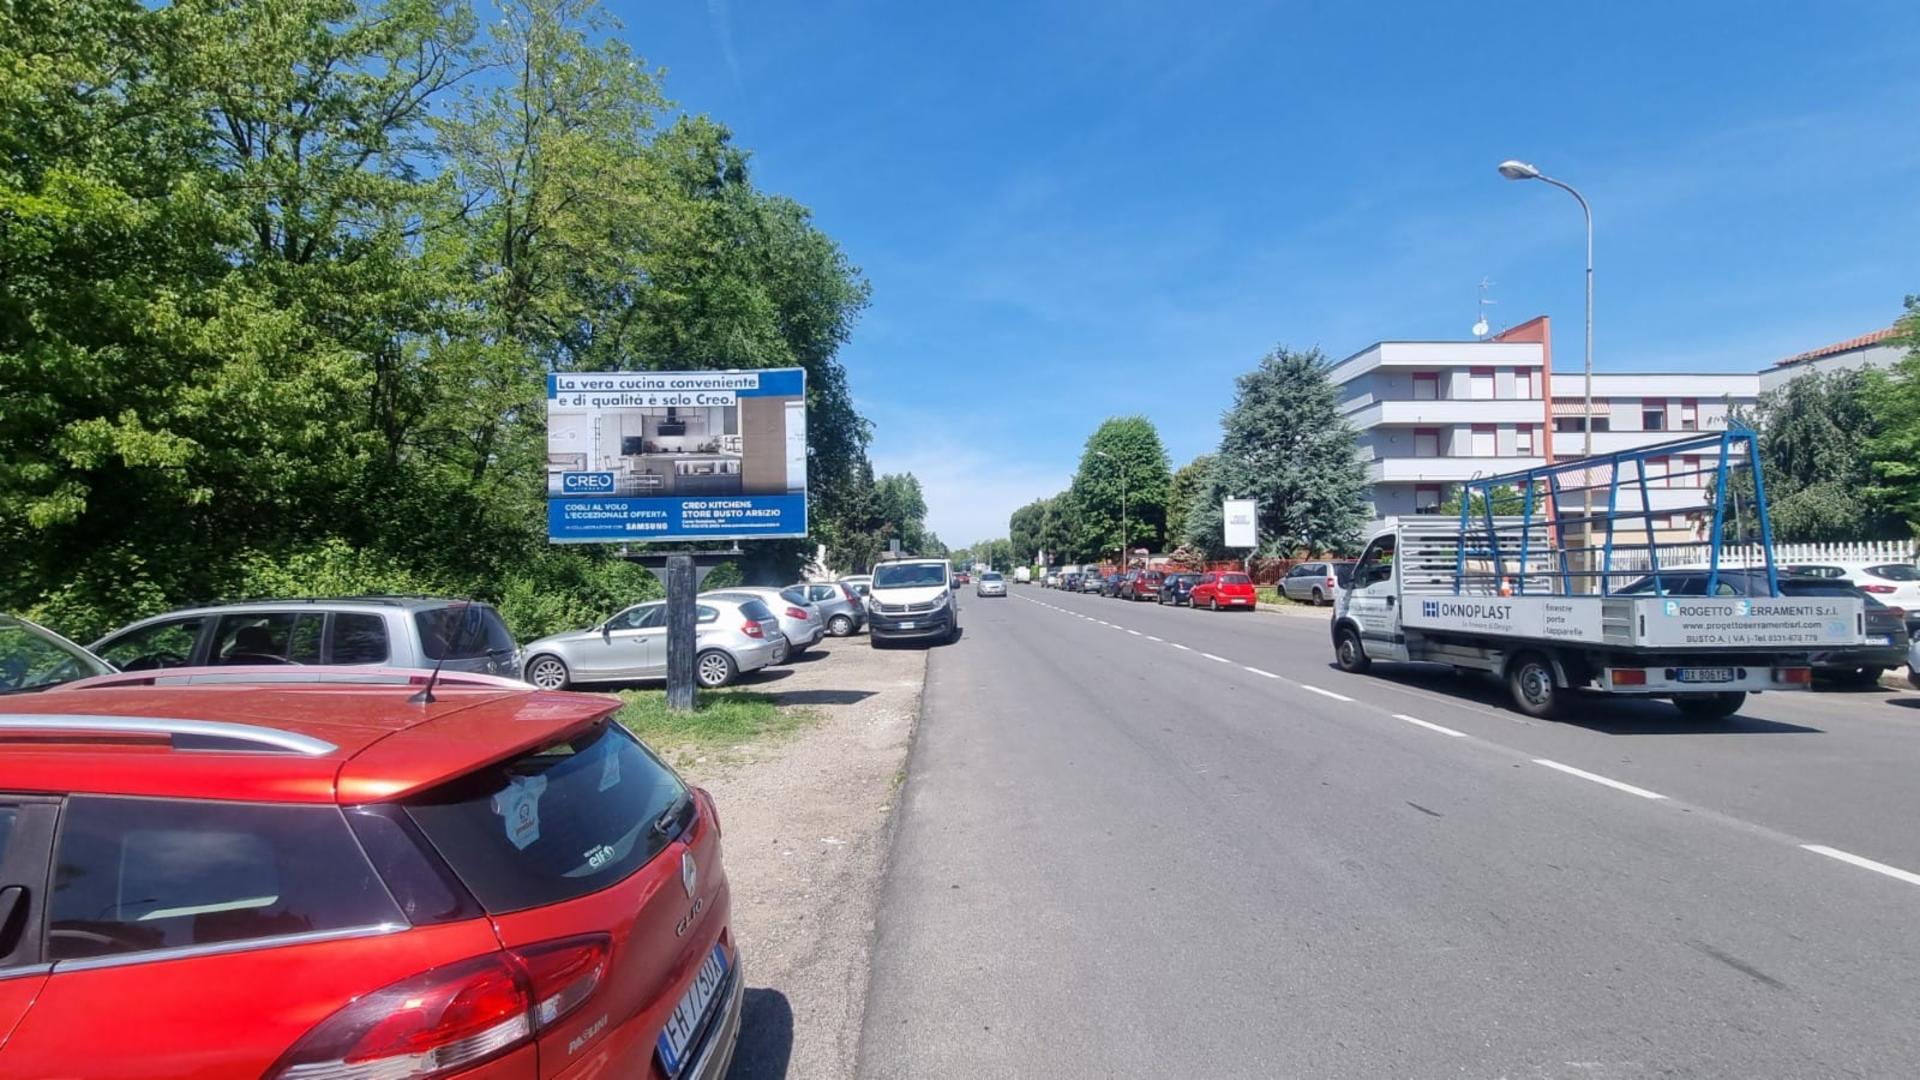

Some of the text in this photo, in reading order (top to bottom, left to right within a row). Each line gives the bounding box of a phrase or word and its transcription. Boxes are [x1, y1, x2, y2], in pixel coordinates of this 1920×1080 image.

[558, 376, 758, 390] La vera cucina conveniente
[558, 397, 568, 407] e
[572, 394, 587, 406] di
[591, 393, 644, 409] qualità
[648, 394, 658, 405] è
[663, 393, 692, 406] solo
[566, 475, 612, 487] CREO
[682, 500, 752, 509] CREO KITCHENS
[564, 511, 628, 519] L'ECCEZIONALE
[682, 509, 781, 518] STORE BUSTO ARSIZIO
[625, 522, 668, 531] SAMSUNG
[1442, 603, 1512, 620] OKNOPLAST
[589, 850, 605, 868] elf
[675, 896, 703, 937] CLIO
